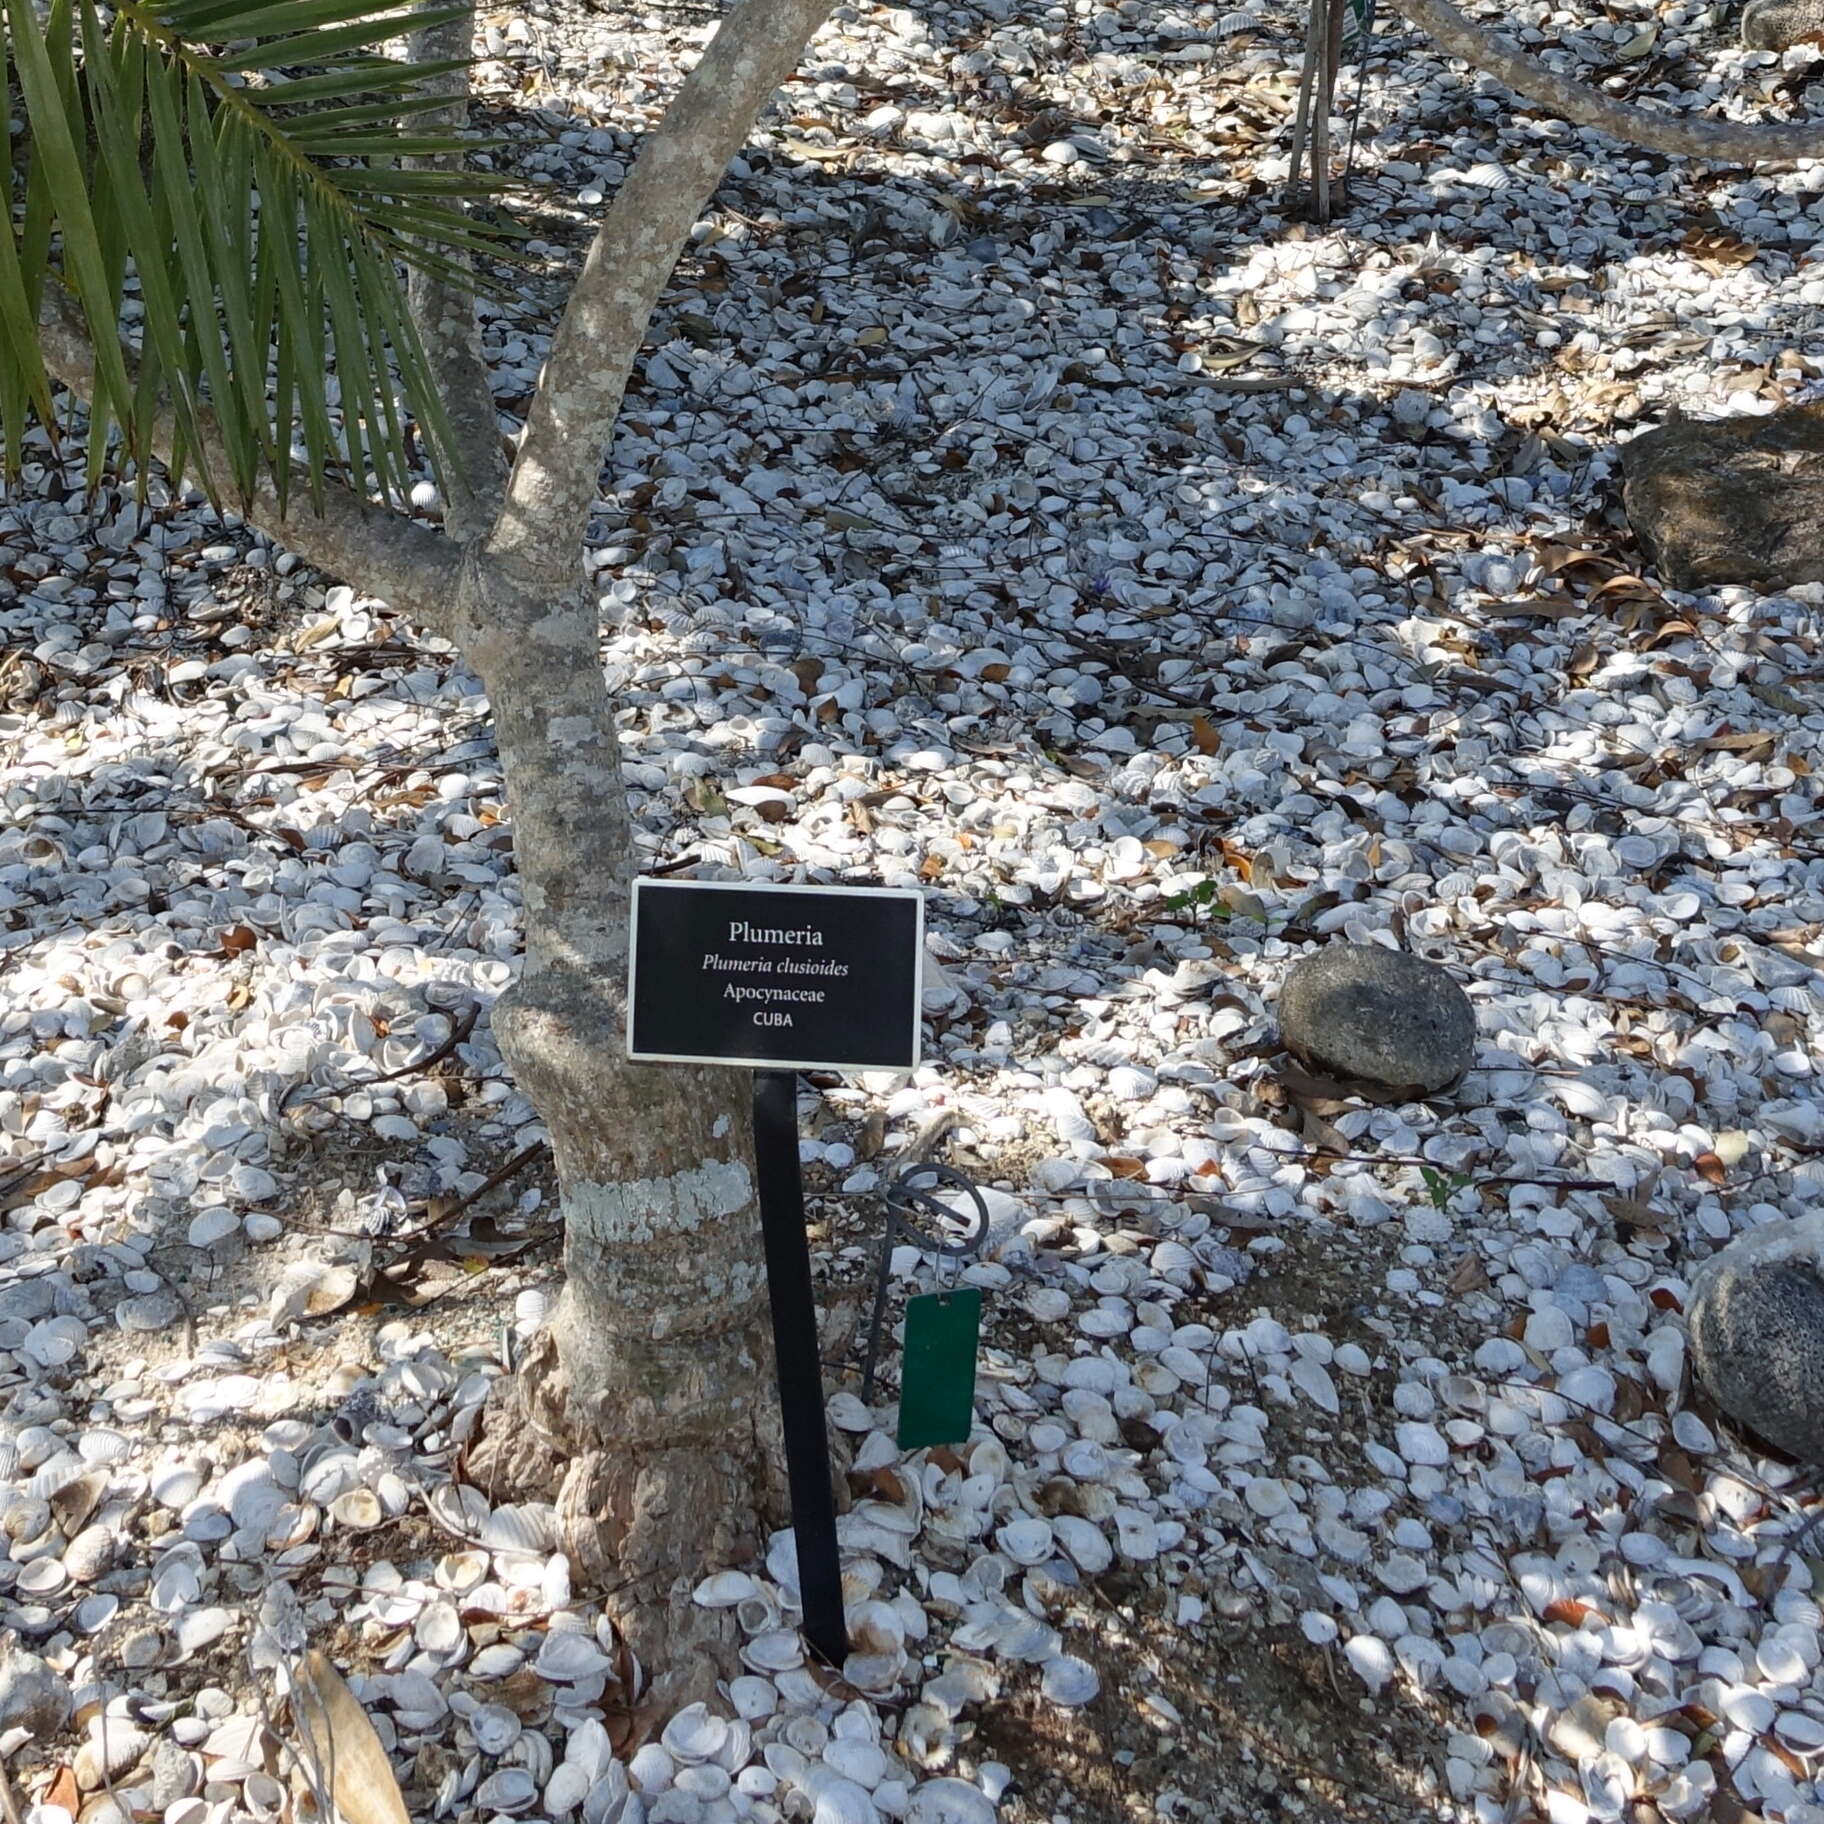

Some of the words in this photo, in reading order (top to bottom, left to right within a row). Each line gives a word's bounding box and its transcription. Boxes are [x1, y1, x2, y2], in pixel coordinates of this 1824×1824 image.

[728, 921, 824, 946] Plumeria
[702, 953, 773, 973] Plumeria
[776, 957, 849, 977] clusioides
[723, 982, 825, 1004] Apocynaceae
[752, 1011, 793, 1027] CUBA
